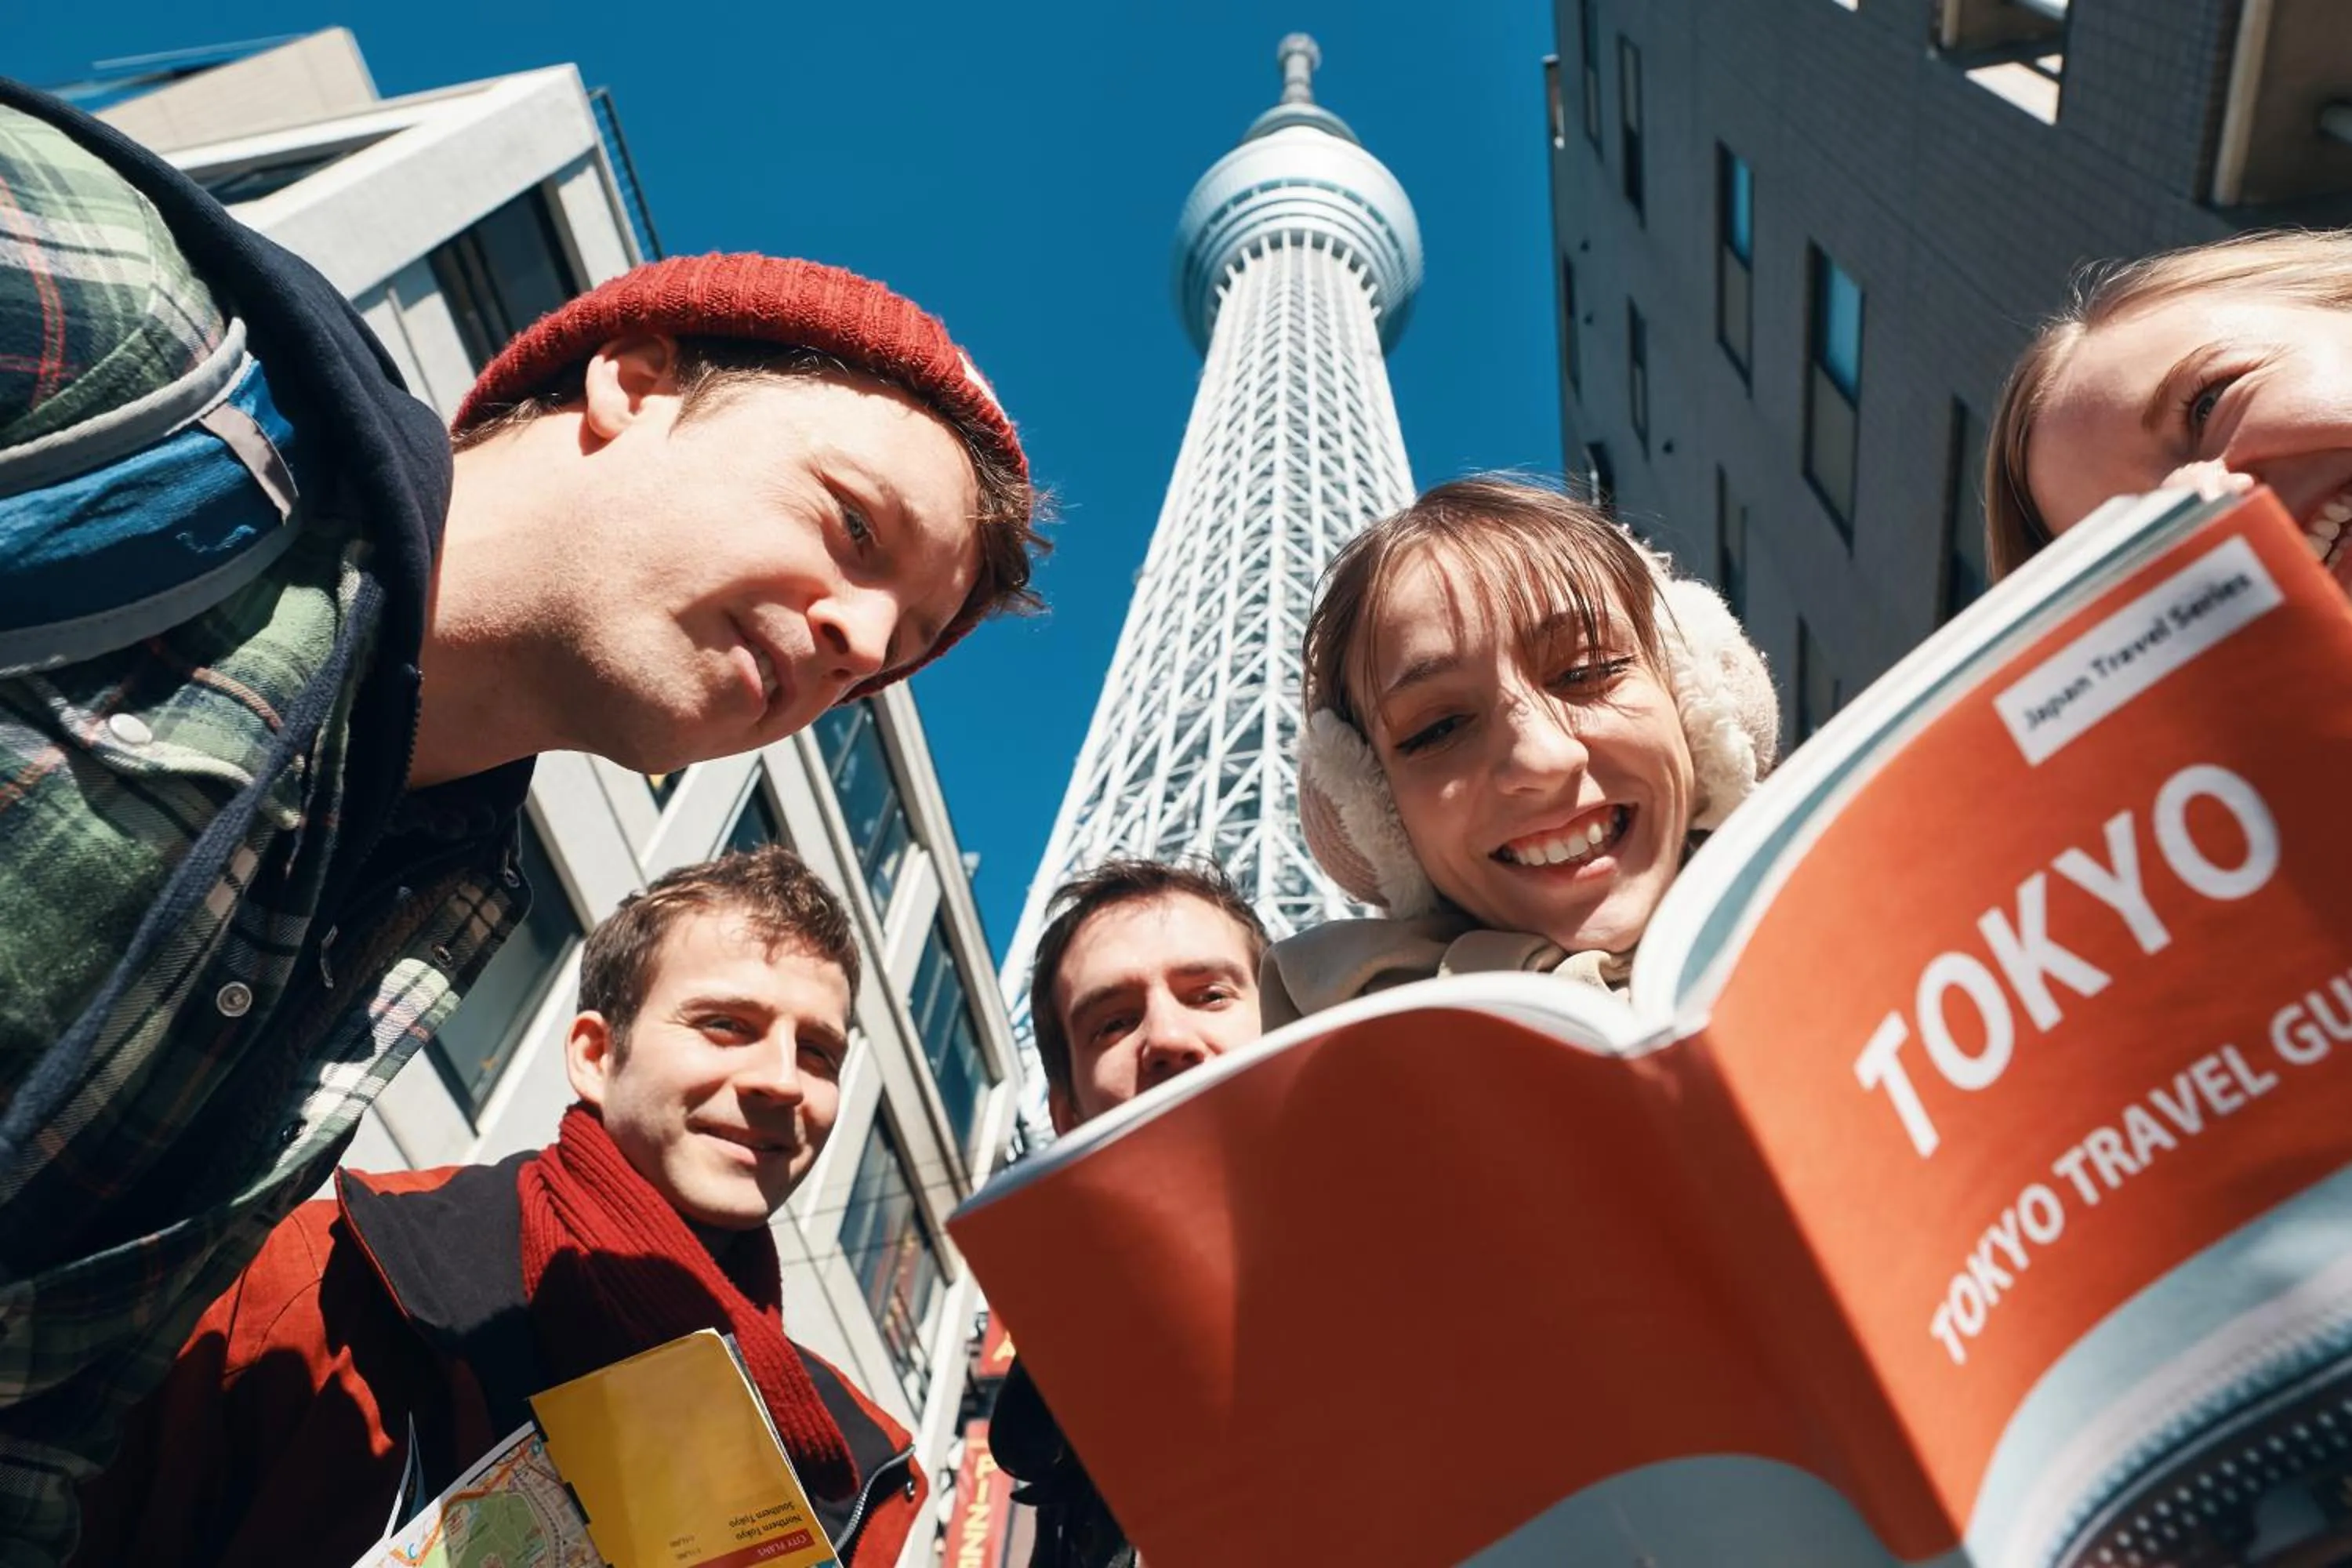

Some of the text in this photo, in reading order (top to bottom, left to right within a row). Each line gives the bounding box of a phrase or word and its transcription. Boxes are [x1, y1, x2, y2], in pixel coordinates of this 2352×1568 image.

[2025, 573, 2252, 730] Japan Travel Series
[1854, 764, 2281, 1157] TOKYO
[1929, 967, 2352, 1365] TOKYO TRAVEL GU
[728, 1501, 795, 1528] Southern Tokyo
[735, 1514, 803, 1541] Northern Tokyo
